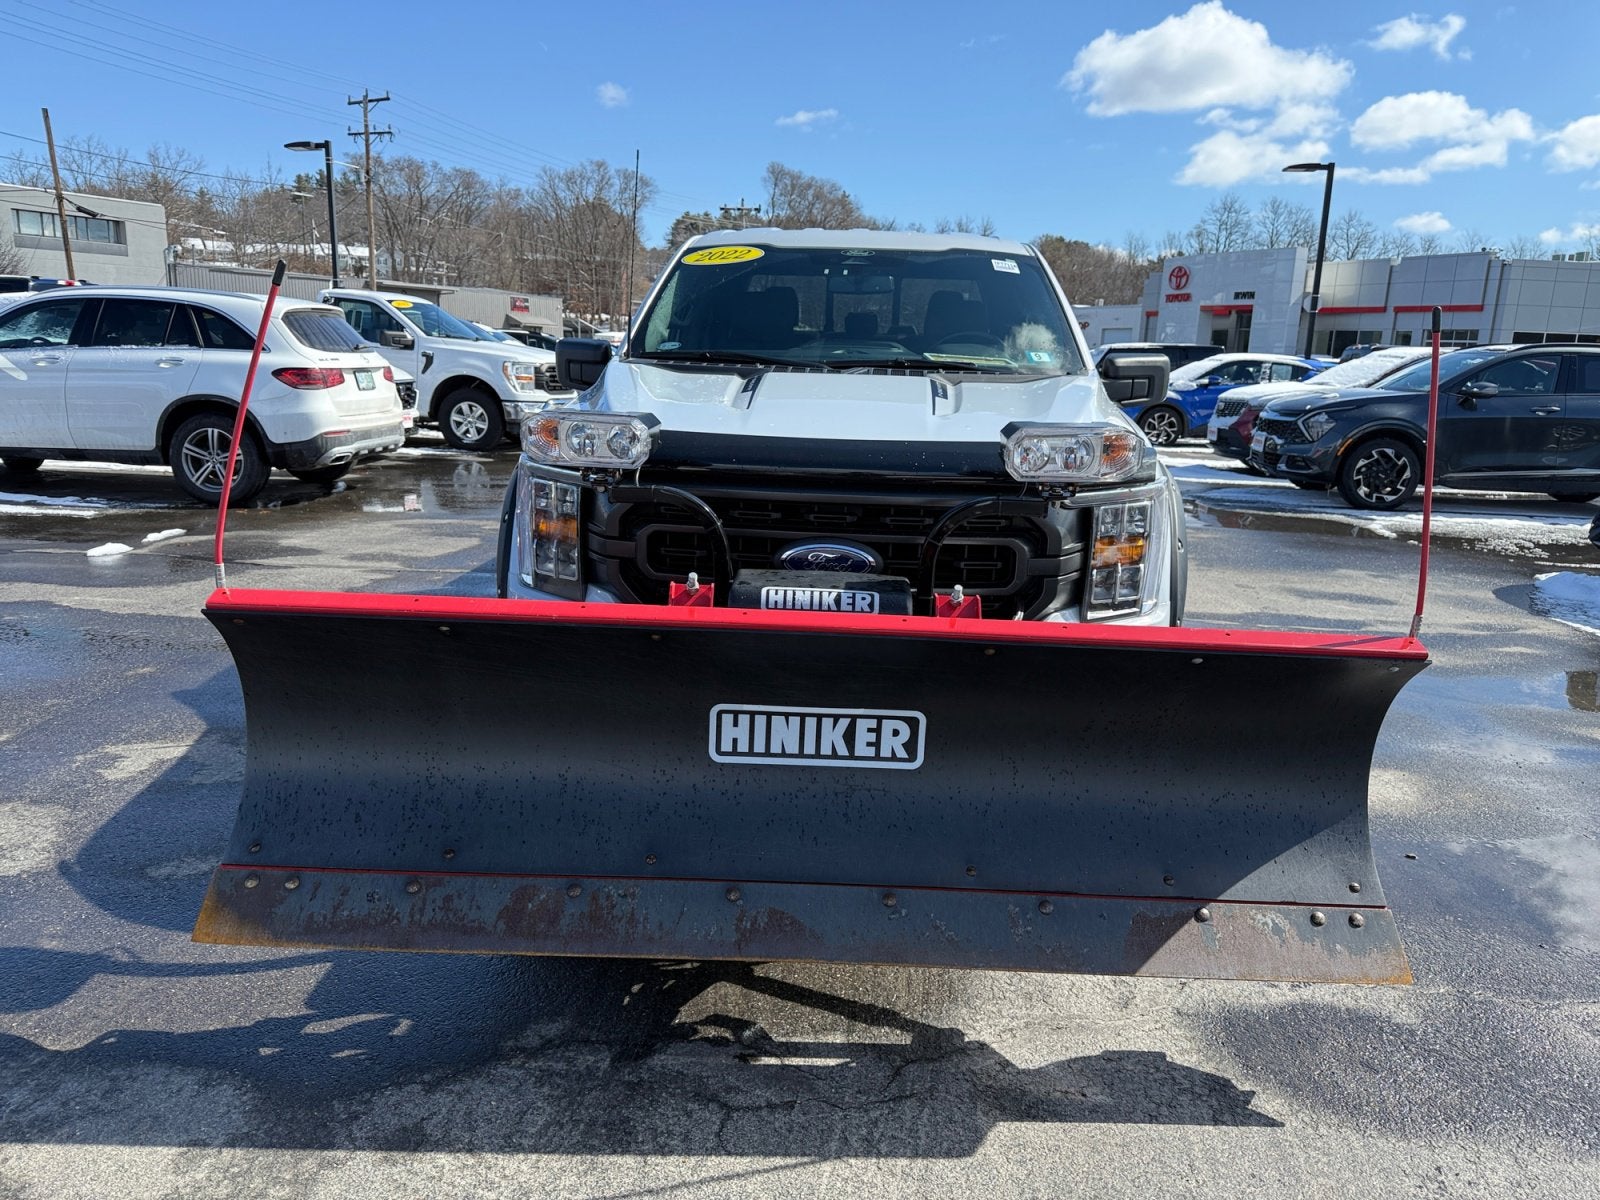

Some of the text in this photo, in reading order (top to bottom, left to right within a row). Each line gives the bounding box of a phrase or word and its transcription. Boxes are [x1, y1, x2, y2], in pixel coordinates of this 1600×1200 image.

[692, 249, 751, 262] 2022
[1165, 292, 1192, 303] TOYOTA
[1233, 291, 1255, 300] IRWIN
[768, 589, 872, 612] HINIKER
[720, 713, 911, 759] HINIKER
